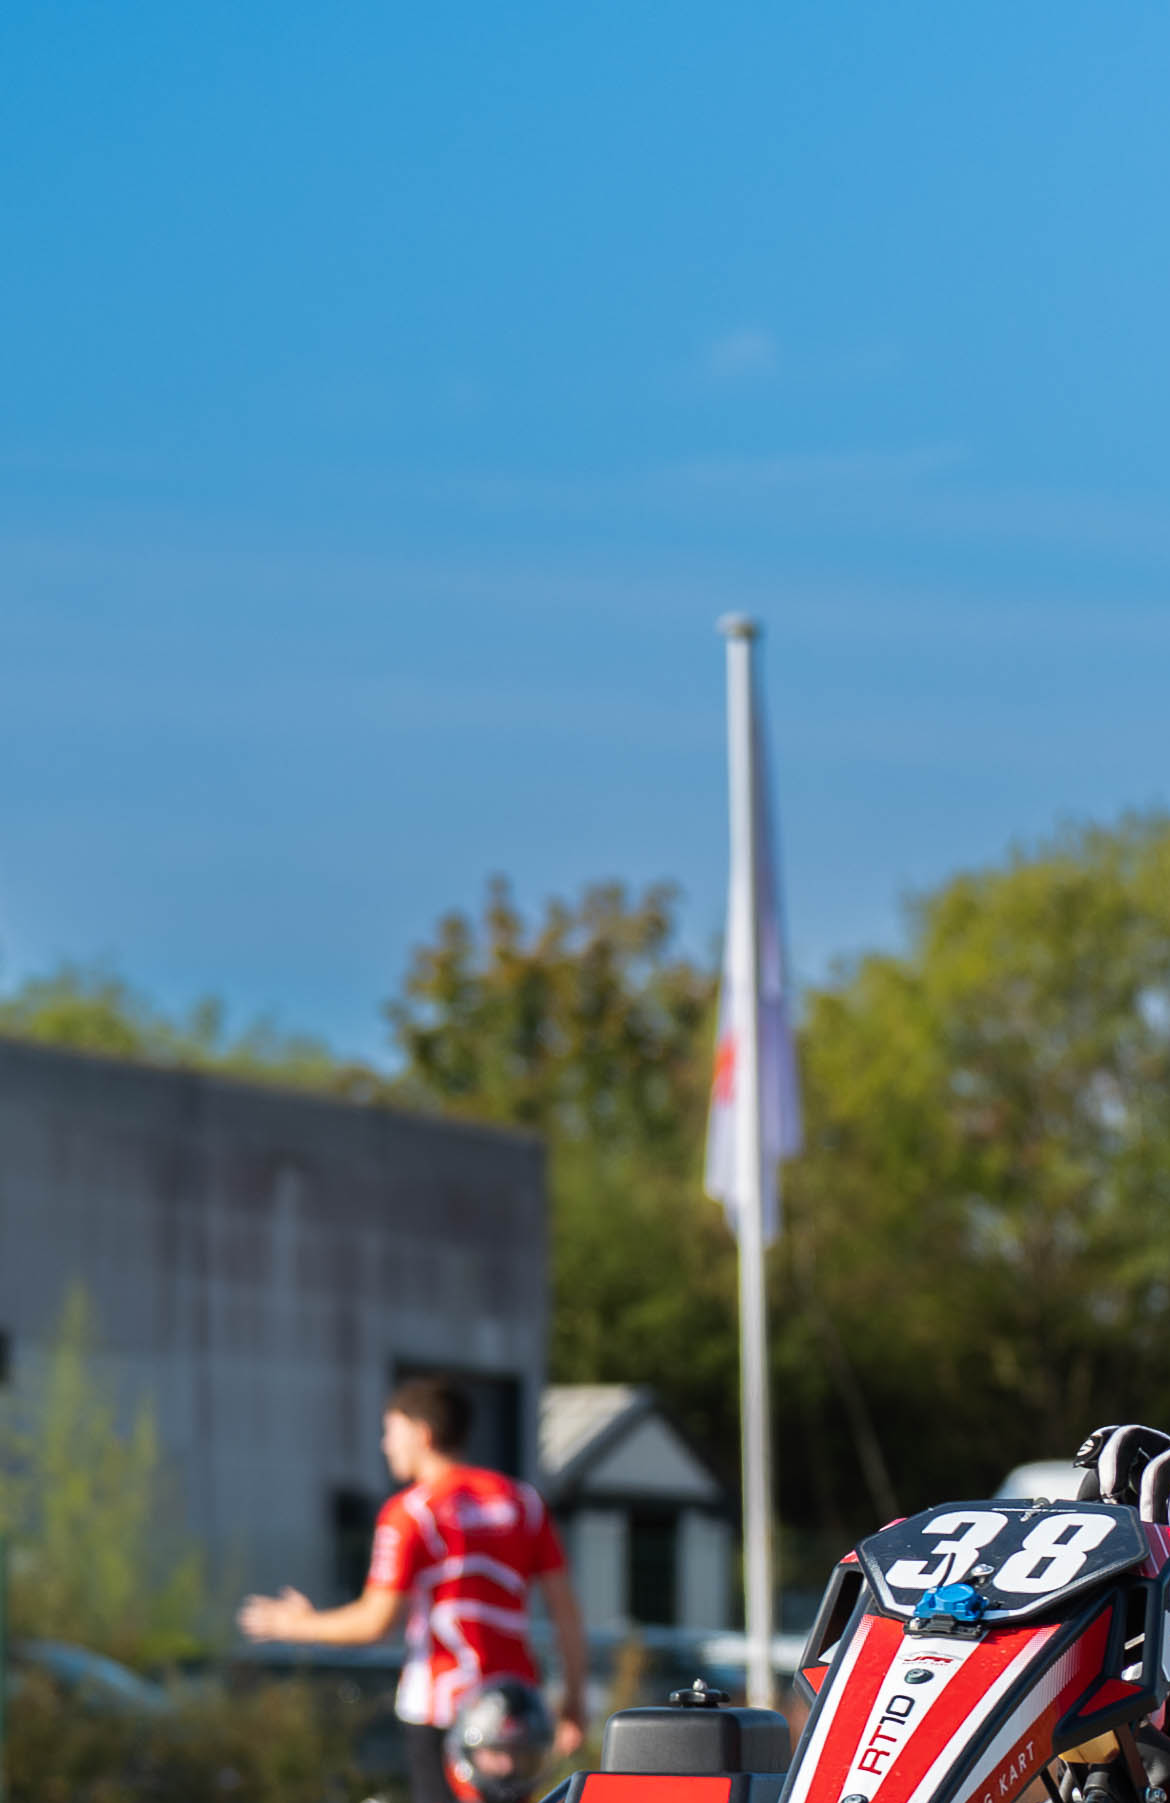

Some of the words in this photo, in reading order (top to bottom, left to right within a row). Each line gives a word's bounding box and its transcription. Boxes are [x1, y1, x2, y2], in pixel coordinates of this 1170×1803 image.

[885, 1510, 1117, 1594] 38
[857, 1694, 916, 1776] RT10
[998, 1741, 1036, 1797] KART
